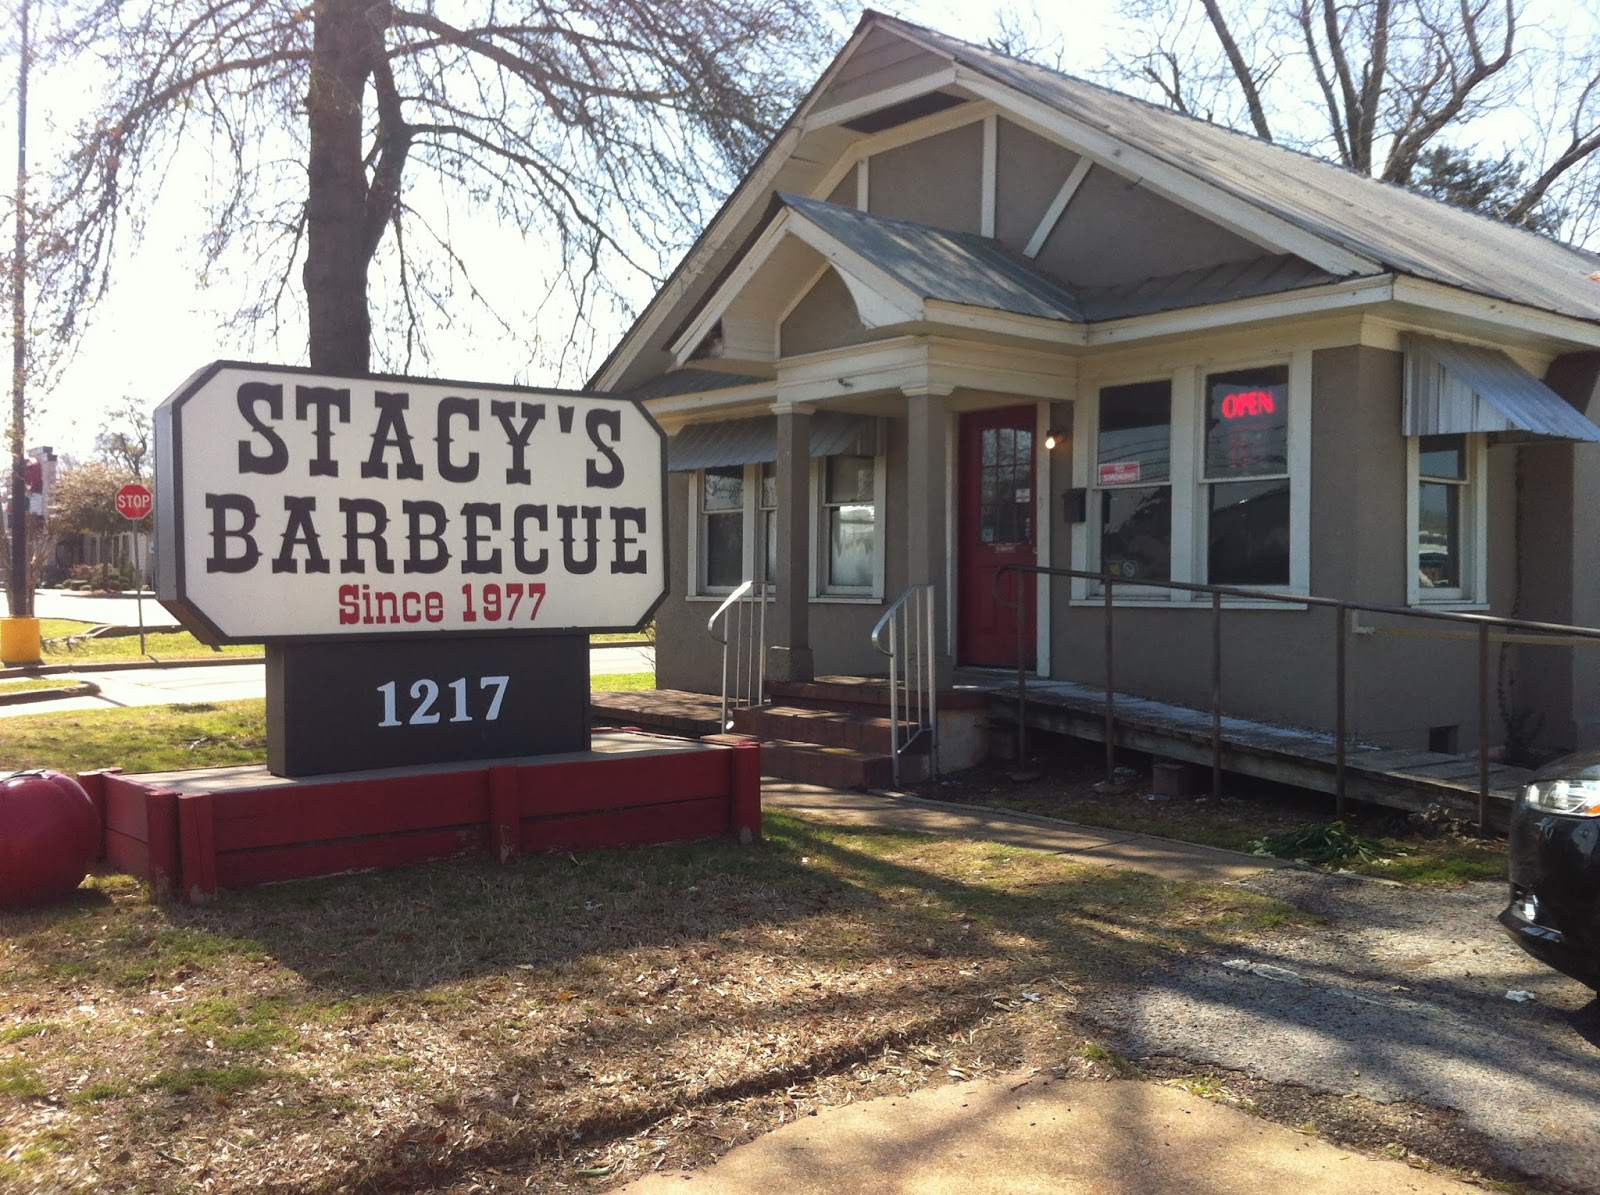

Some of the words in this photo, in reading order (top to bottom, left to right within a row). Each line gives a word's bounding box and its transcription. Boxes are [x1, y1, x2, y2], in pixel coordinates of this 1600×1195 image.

[1222, 390, 1275, 418] OPEN
[237, 381, 625, 490] STACY'S
[118, 494, 151, 508] STOP
[205, 494, 648, 575] BARBECUE
[338, 584, 444, 626] Since
[461, 583, 547, 622] 1977
[376, 675, 510, 728] 1217
